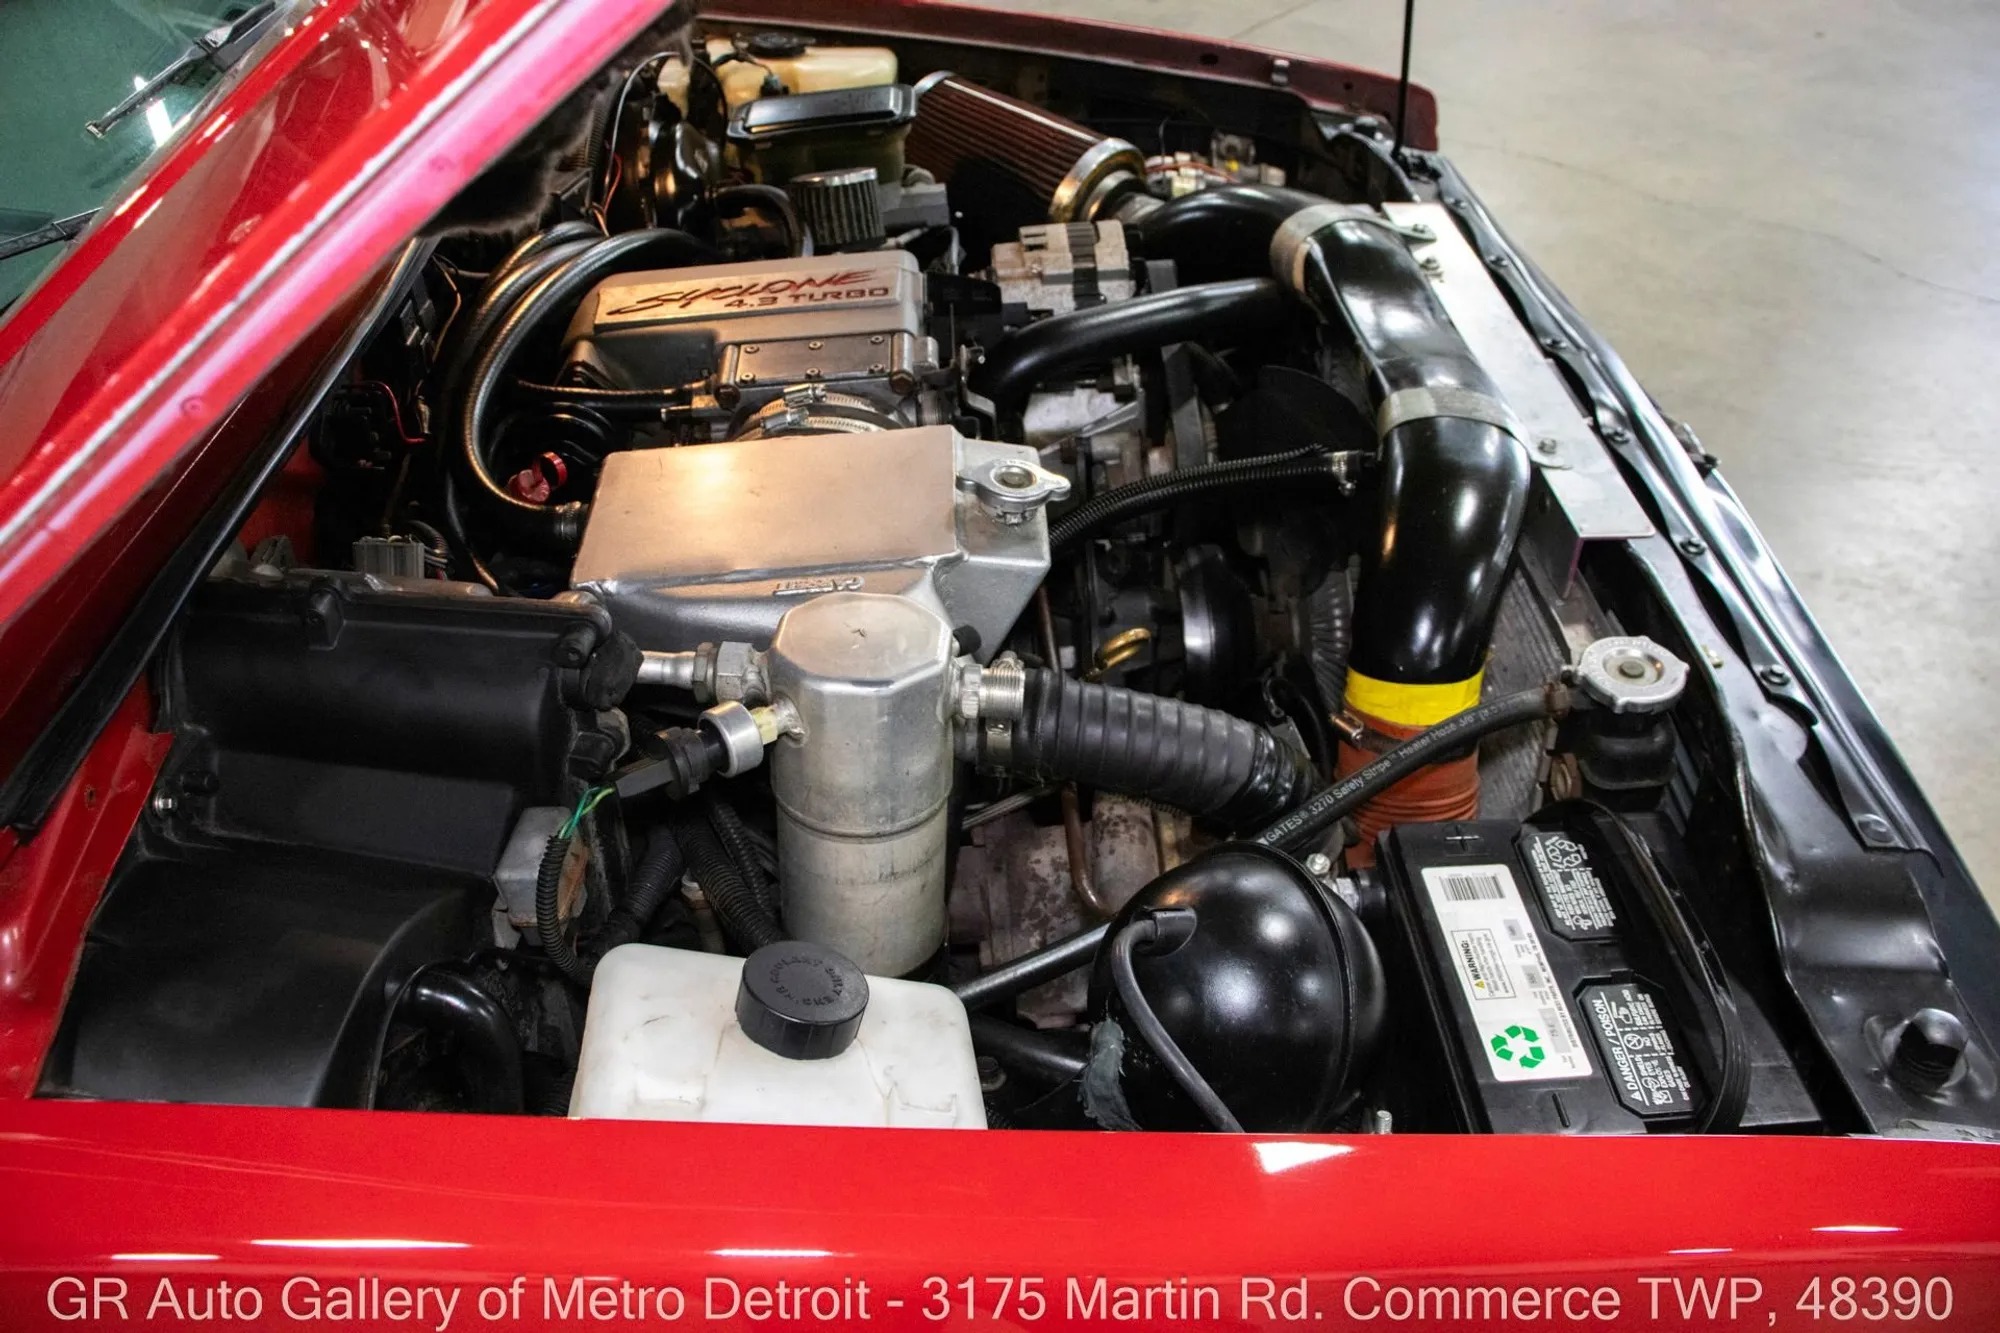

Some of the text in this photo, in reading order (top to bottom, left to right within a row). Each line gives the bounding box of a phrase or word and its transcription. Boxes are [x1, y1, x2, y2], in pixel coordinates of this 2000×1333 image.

[724, 287, 890, 309] 4.3 TURBO
[1309, 795, 1334, 816] 3270
[1334, 775, 1365, 801] Safety
[1430, 722, 1457, 745] Hose
[1461, 940, 1481, 980] WARNING:
[1592, 1000, 1616, 1037] POISON
[1612, 1046, 1638, 1090] DANGER
